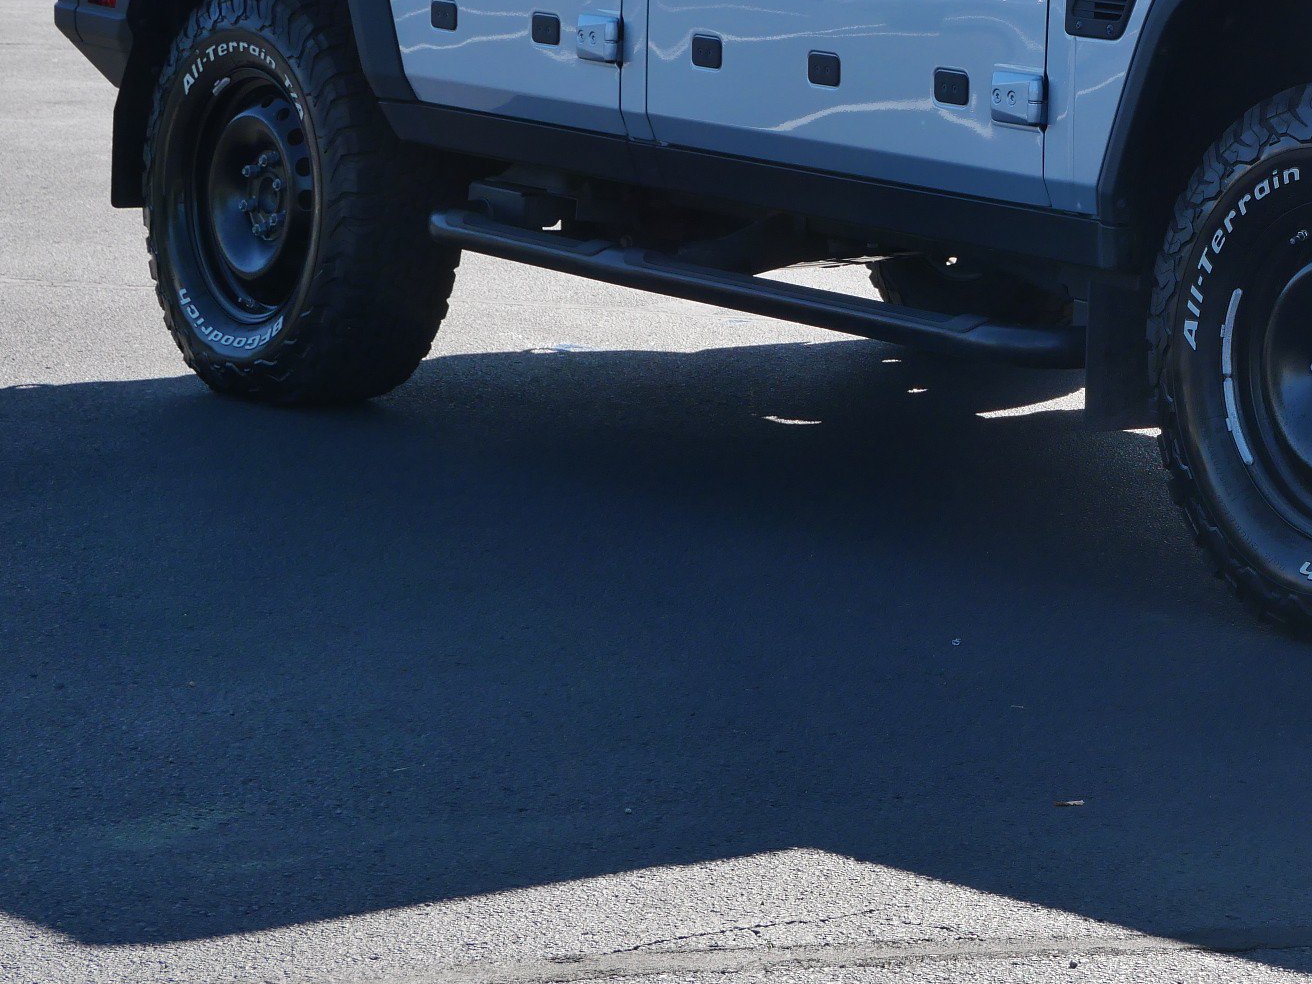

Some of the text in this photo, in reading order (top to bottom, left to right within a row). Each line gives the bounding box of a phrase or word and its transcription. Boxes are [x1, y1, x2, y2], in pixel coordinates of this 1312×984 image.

[182, 40, 276, 95] All-Terrain
[1182, 165, 1300, 352] All-Terrain
[178, 287, 285, 351] BFGoodrich
